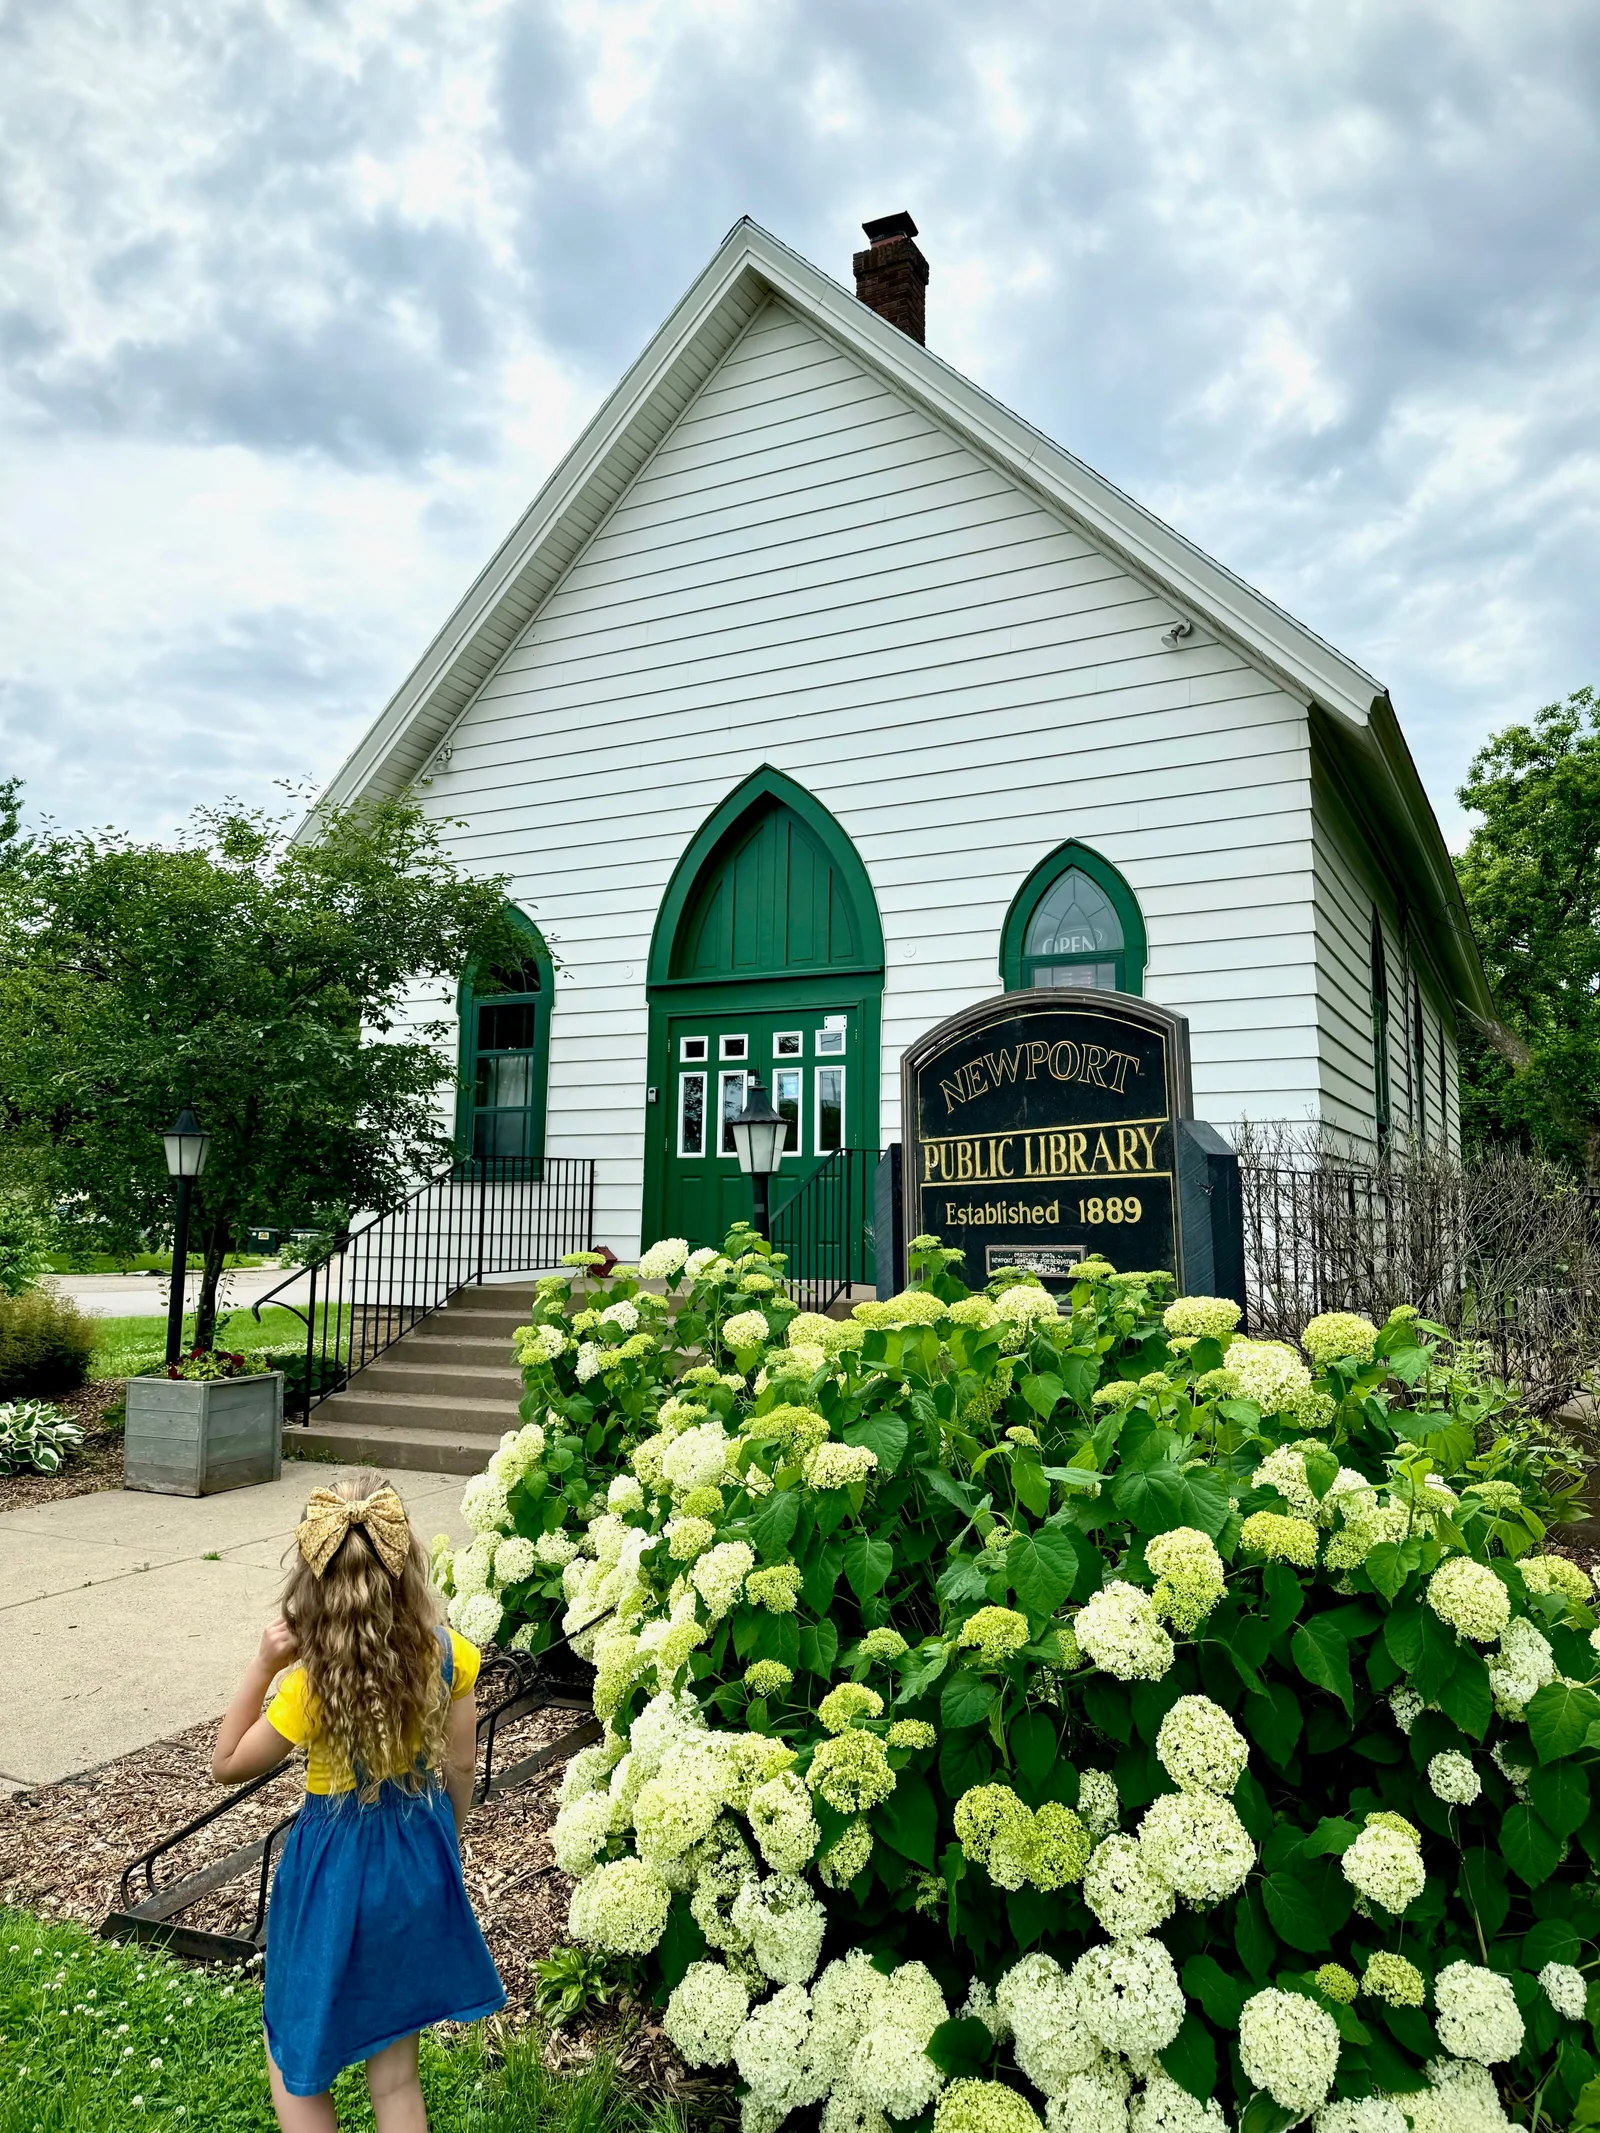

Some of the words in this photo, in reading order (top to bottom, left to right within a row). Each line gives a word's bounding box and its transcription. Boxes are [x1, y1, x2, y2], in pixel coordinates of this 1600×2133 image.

[1042, 935, 1096, 954] OPEN
[939, 1040, 1140, 1114] NEWPORT
[923, 1138, 1015, 1181] PUBLIC
[1024, 1126, 1162, 1176] LIBRARY
[945, 1200, 1060, 1225] Established
[1079, 1197, 1142, 1224] 1889
